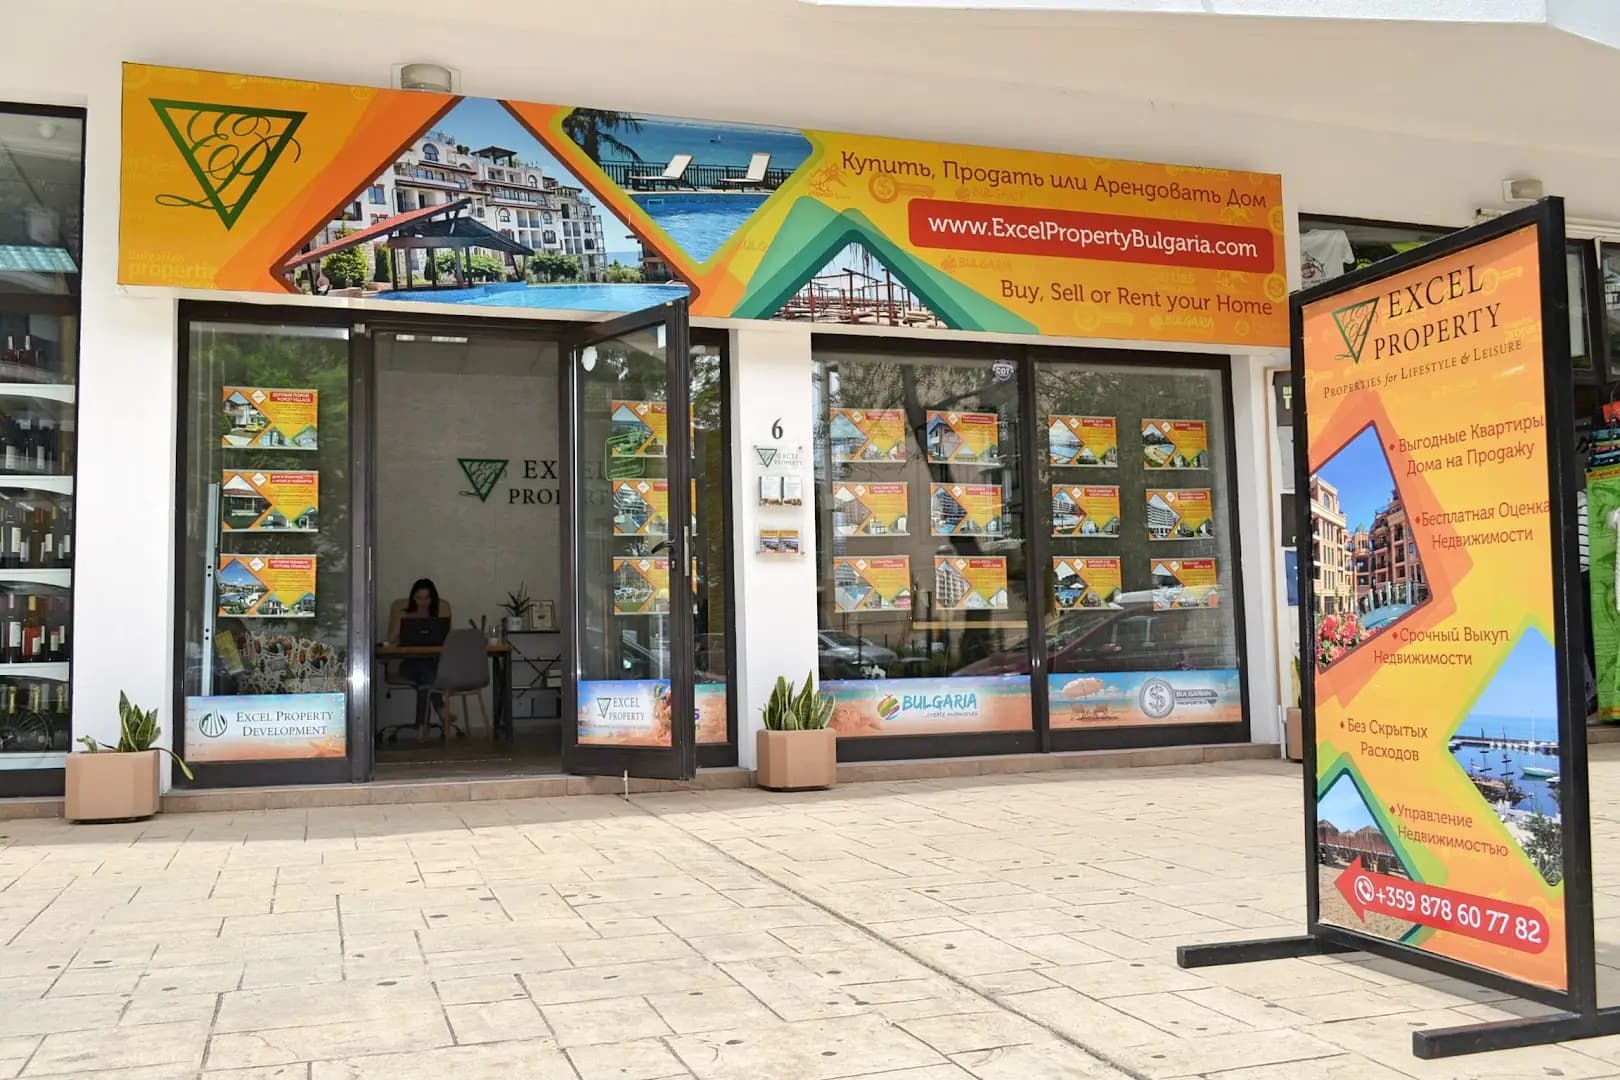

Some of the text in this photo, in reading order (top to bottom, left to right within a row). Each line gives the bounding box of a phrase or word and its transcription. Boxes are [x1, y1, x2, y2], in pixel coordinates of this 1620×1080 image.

[841, 151, 1267, 208] Купить, Продать или Арендовать Дом
[928, 217, 1258, 258] www.ExcelPropertyBulgaria.com
[1001, 280, 1273, 316] Buy, Sell or Rent your Home
[1386, 264, 1483, 319] EXCEL
[1374, 302, 1502, 360] PROPERTY
[1383, 372, 1398, 387] for
[1401, 355, 1457, 380] LIFESTYLE
[1460, 351, 1471, 365] &
[1473, 339, 1522, 361] LEISURE
[771, 418, 784, 440] 6
[1399, 414, 1545, 453] Выгодные Квартиры
[1406, 440, 1535, 477] Дома на Продажу
[1421, 499, 1551, 528] Бесплатная Оценка
[1432, 528, 1534, 550] Недвижимости
[1400, 626, 1509, 645] Срочный Выкуп
[1374, 650, 1473, 666] Недвижимости
[613, 697, 640, 707] EXCEL
[902, 693, 977, 711] BULGARIA
[236, 711, 334, 722] EXCEL PROPERTY
[609, 711, 645, 721] PROPERTY
[1347, 718, 1428, 739] Без Скрытых
[243, 725, 327, 737] DEVELOPMENT
[1360, 741, 1419, 762] Расходов
[1396, 803, 1473, 828] Управление
[1397, 825, 1509, 857] Недвижимостью
[1375, 886, 1542, 943] +359 878 60 77 82
